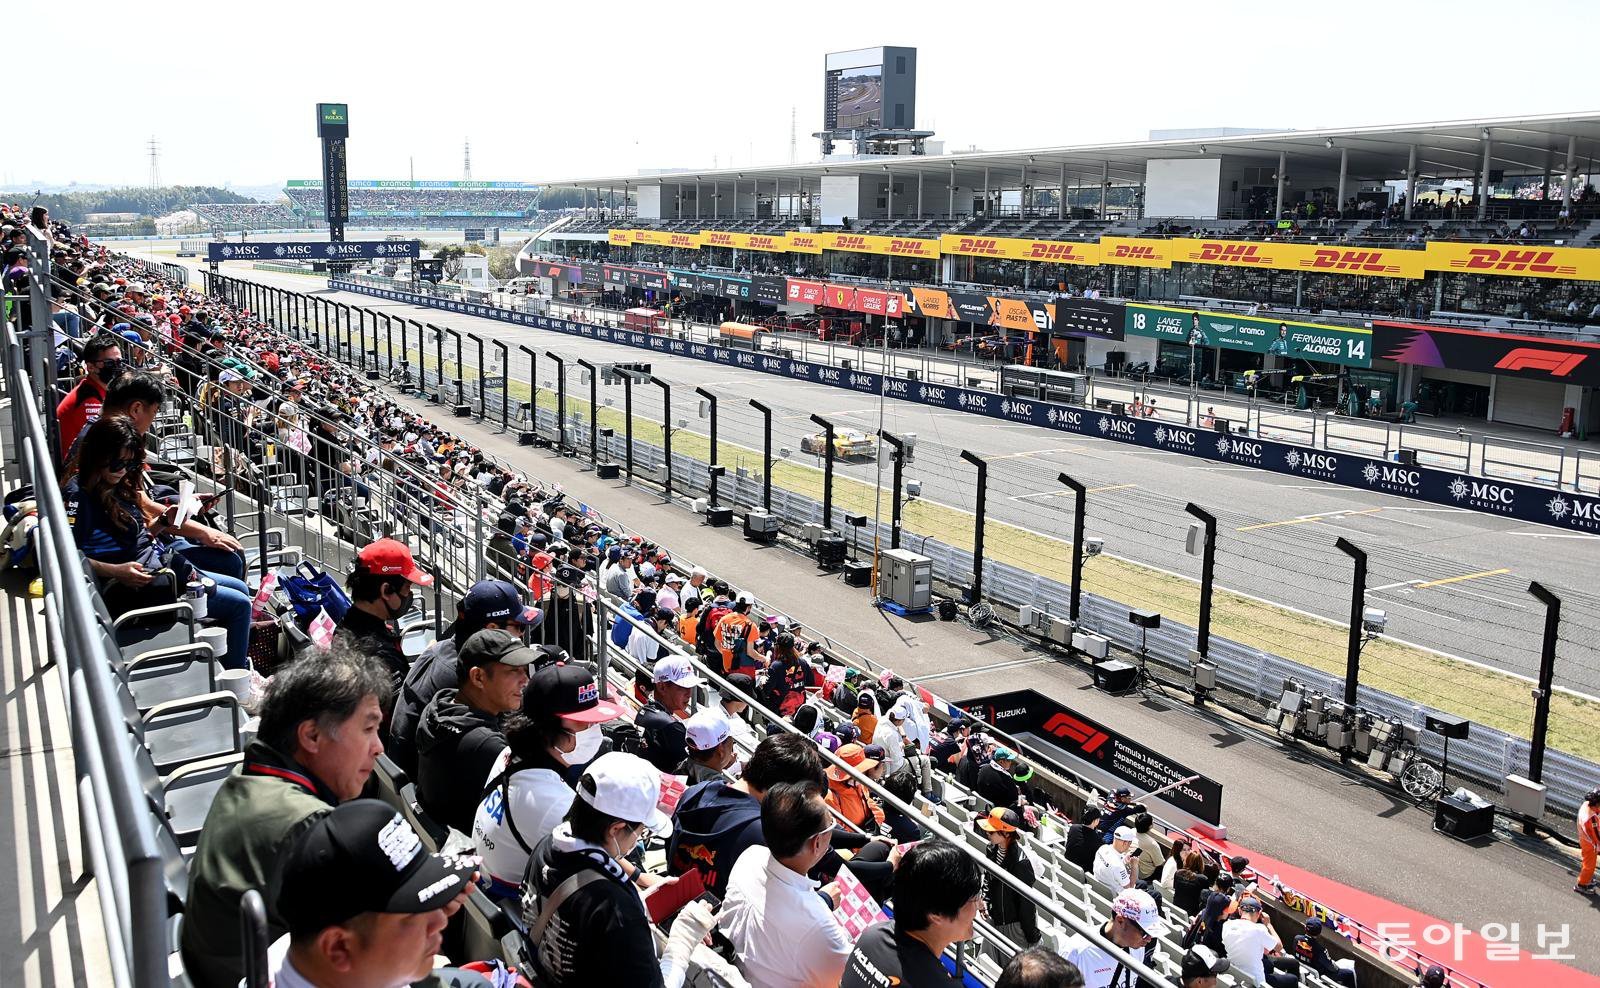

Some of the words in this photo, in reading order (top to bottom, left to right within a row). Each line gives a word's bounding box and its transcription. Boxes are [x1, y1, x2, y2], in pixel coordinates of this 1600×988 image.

[710, 234, 731, 245] DHL
[750, 237, 773, 249] DHL
[794, 238, 814, 247] DHL
[837, 236, 865, 249] DHL
[234, 246, 260, 254] MSC
[287, 246, 311, 254] MSC
[338, 245, 362, 253] MSC
[388, 244, 410, 252] MSC
[891, 240, 924, 254] DHL
[959, 238, 998, 254] DHL
[1031, 244, 1076, 260] DHL
[1115, 245, 1156, 259] DHL
[1200, 244, 1261, 264] DHL
[1313, 250, 1386, 272] DHL
[1467, 248, 1558, 273] DHL
[741, 287, 749, 297] 63
[1006, 315, 1027, 323] PIASTRI
[1133, 313, 1146, 330] 18
[1157, 317, 1182, 326] LANCE
[1156, 325, 1183, 335] STROLL
[1239, 326, 1265, 336] aramco
[635, 335, 644, 343] MSC
[654, 338, 663, 346] MSC
[1291, 333, 1341, 346] FERNANDO
[674, 341, 684, 350] MSC
[696, 345, 706, 354] MSC
[1303, 344, 1341, 356] ALONSO
[1346, 339, 1365, 360] 14
[718, 349, 730, 359] MSC
[742, 354, 754, 364] MSC
[768, 358, 781, 369] MSC
[795, 363, 810, 374] MSC
[1494, 348, 1588, 377] F1
[825, 368, 840, 380] MSC
[857, 374, 872, 386] MSC
[891, 380, 908, 392] MSC
[927, 386, 946, 400] MSC
[967, 394, 987, 408] MSC
[1011, 402, 1032, 416] MSC
[1058, 410, 1082, 425] MSC
[1111, 418, 1136, 434] MSC
[1168, 429, 1195, 445] MSC
[1167, 443, 1195, 451] CRUISES
[1231, 440, 1262, 458] MSC
[1231, 454, 1262, 464] CRUISES
[1303, 452, 1337, 471] MSC
[1302, 468, 1336, 479] CRUISES
[1381, 466, 1420, 486] MSC
[1381, 483, 1420, 495] CRUISES
[1471, 482, 1514, 503] MSC
[1470, 500, 1513, 512] CRUISES
[492, 608, 510, 616] exact
[996, 707, 1027, 719] SUZUKA
[1042, 713, 1110, 753] F1
[1114, 740, 1142, 760] Formula
[1147, 756, 1163, 771] MSC
[1113, 760, 1137, 778] Suzuka
[1138, 773, 1157, 788] 05-07
[1114, 751, 1145, 772] Japanese
[1146, 768, 1167, 783] Grand
[1183, 786, 1203, 802] 2024
[483, 834, 494, 850] App
[853, 947, 890, 988] McLaren
